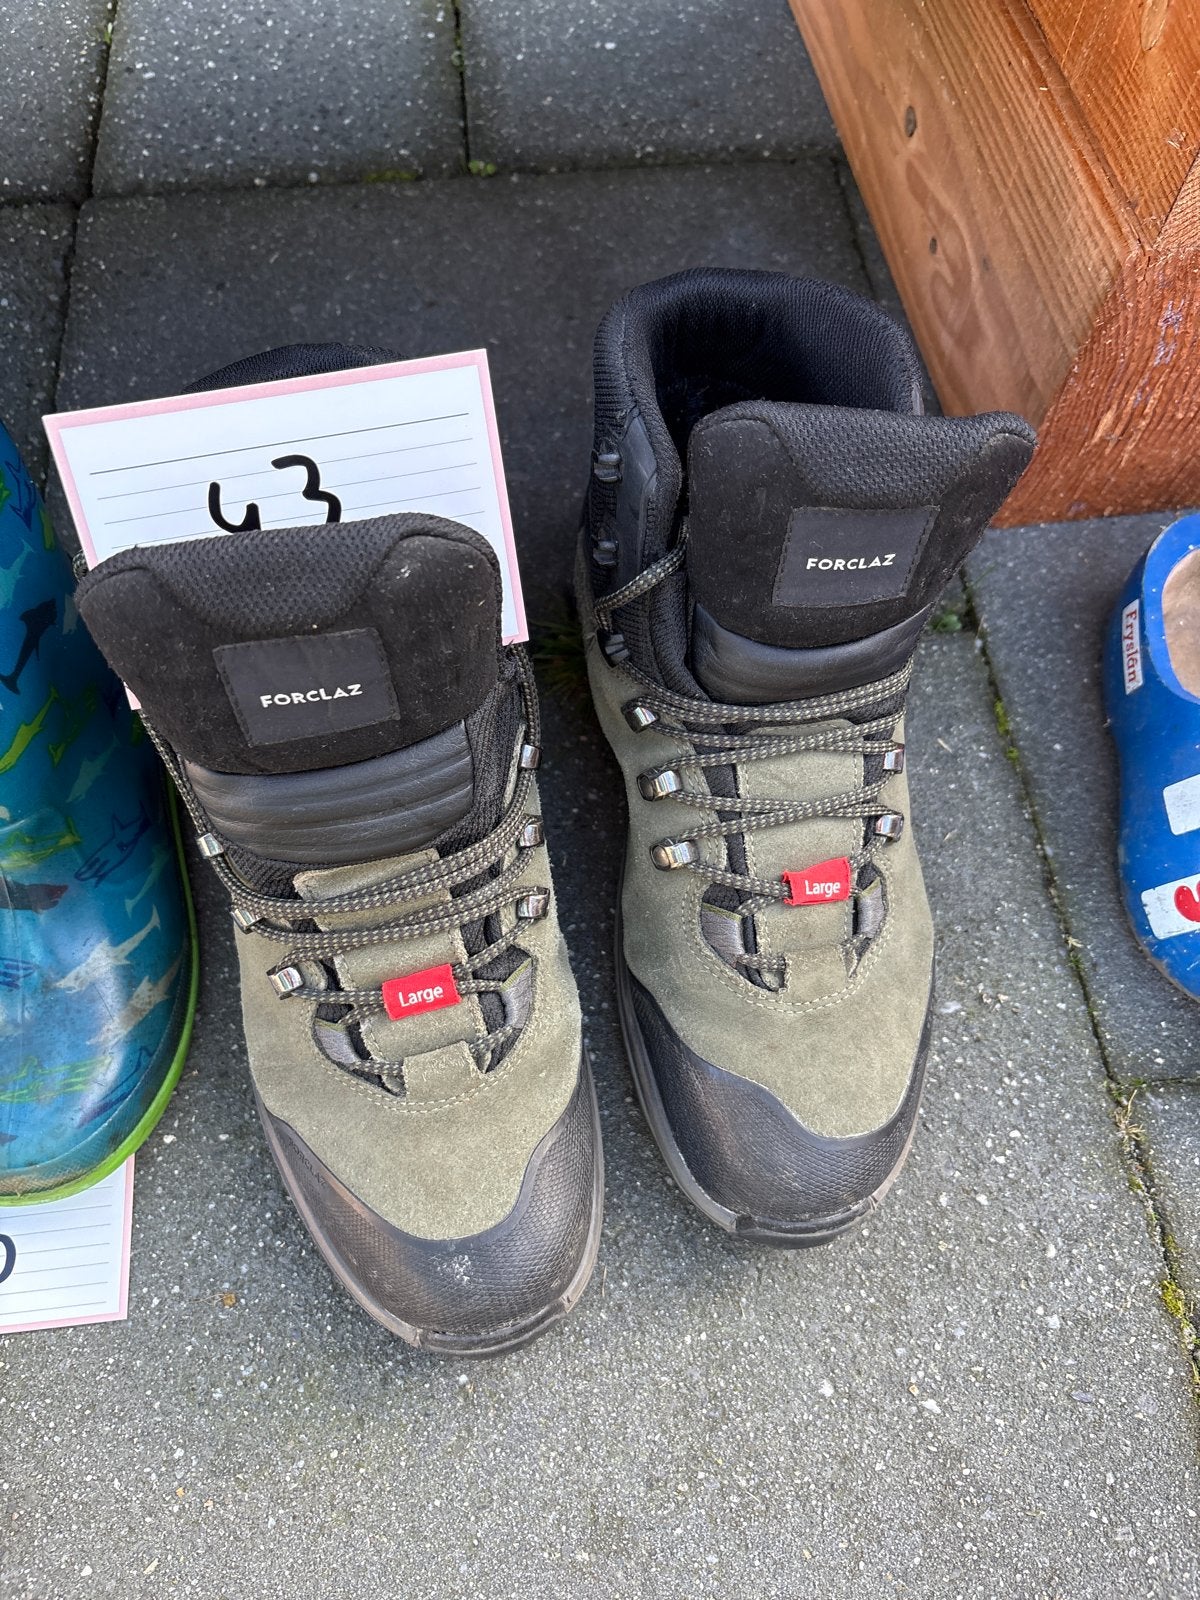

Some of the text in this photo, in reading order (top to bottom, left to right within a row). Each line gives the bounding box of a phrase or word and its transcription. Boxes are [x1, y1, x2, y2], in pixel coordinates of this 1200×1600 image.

[805, 553, 896, 571] FORCLAZ
[1123, 609, 1139, 682] Fryslân
[260, 683, 363, 708] FORCLAZ
[804, 880, 841, 897] Large
[398, 986, 444, 1007] Large
